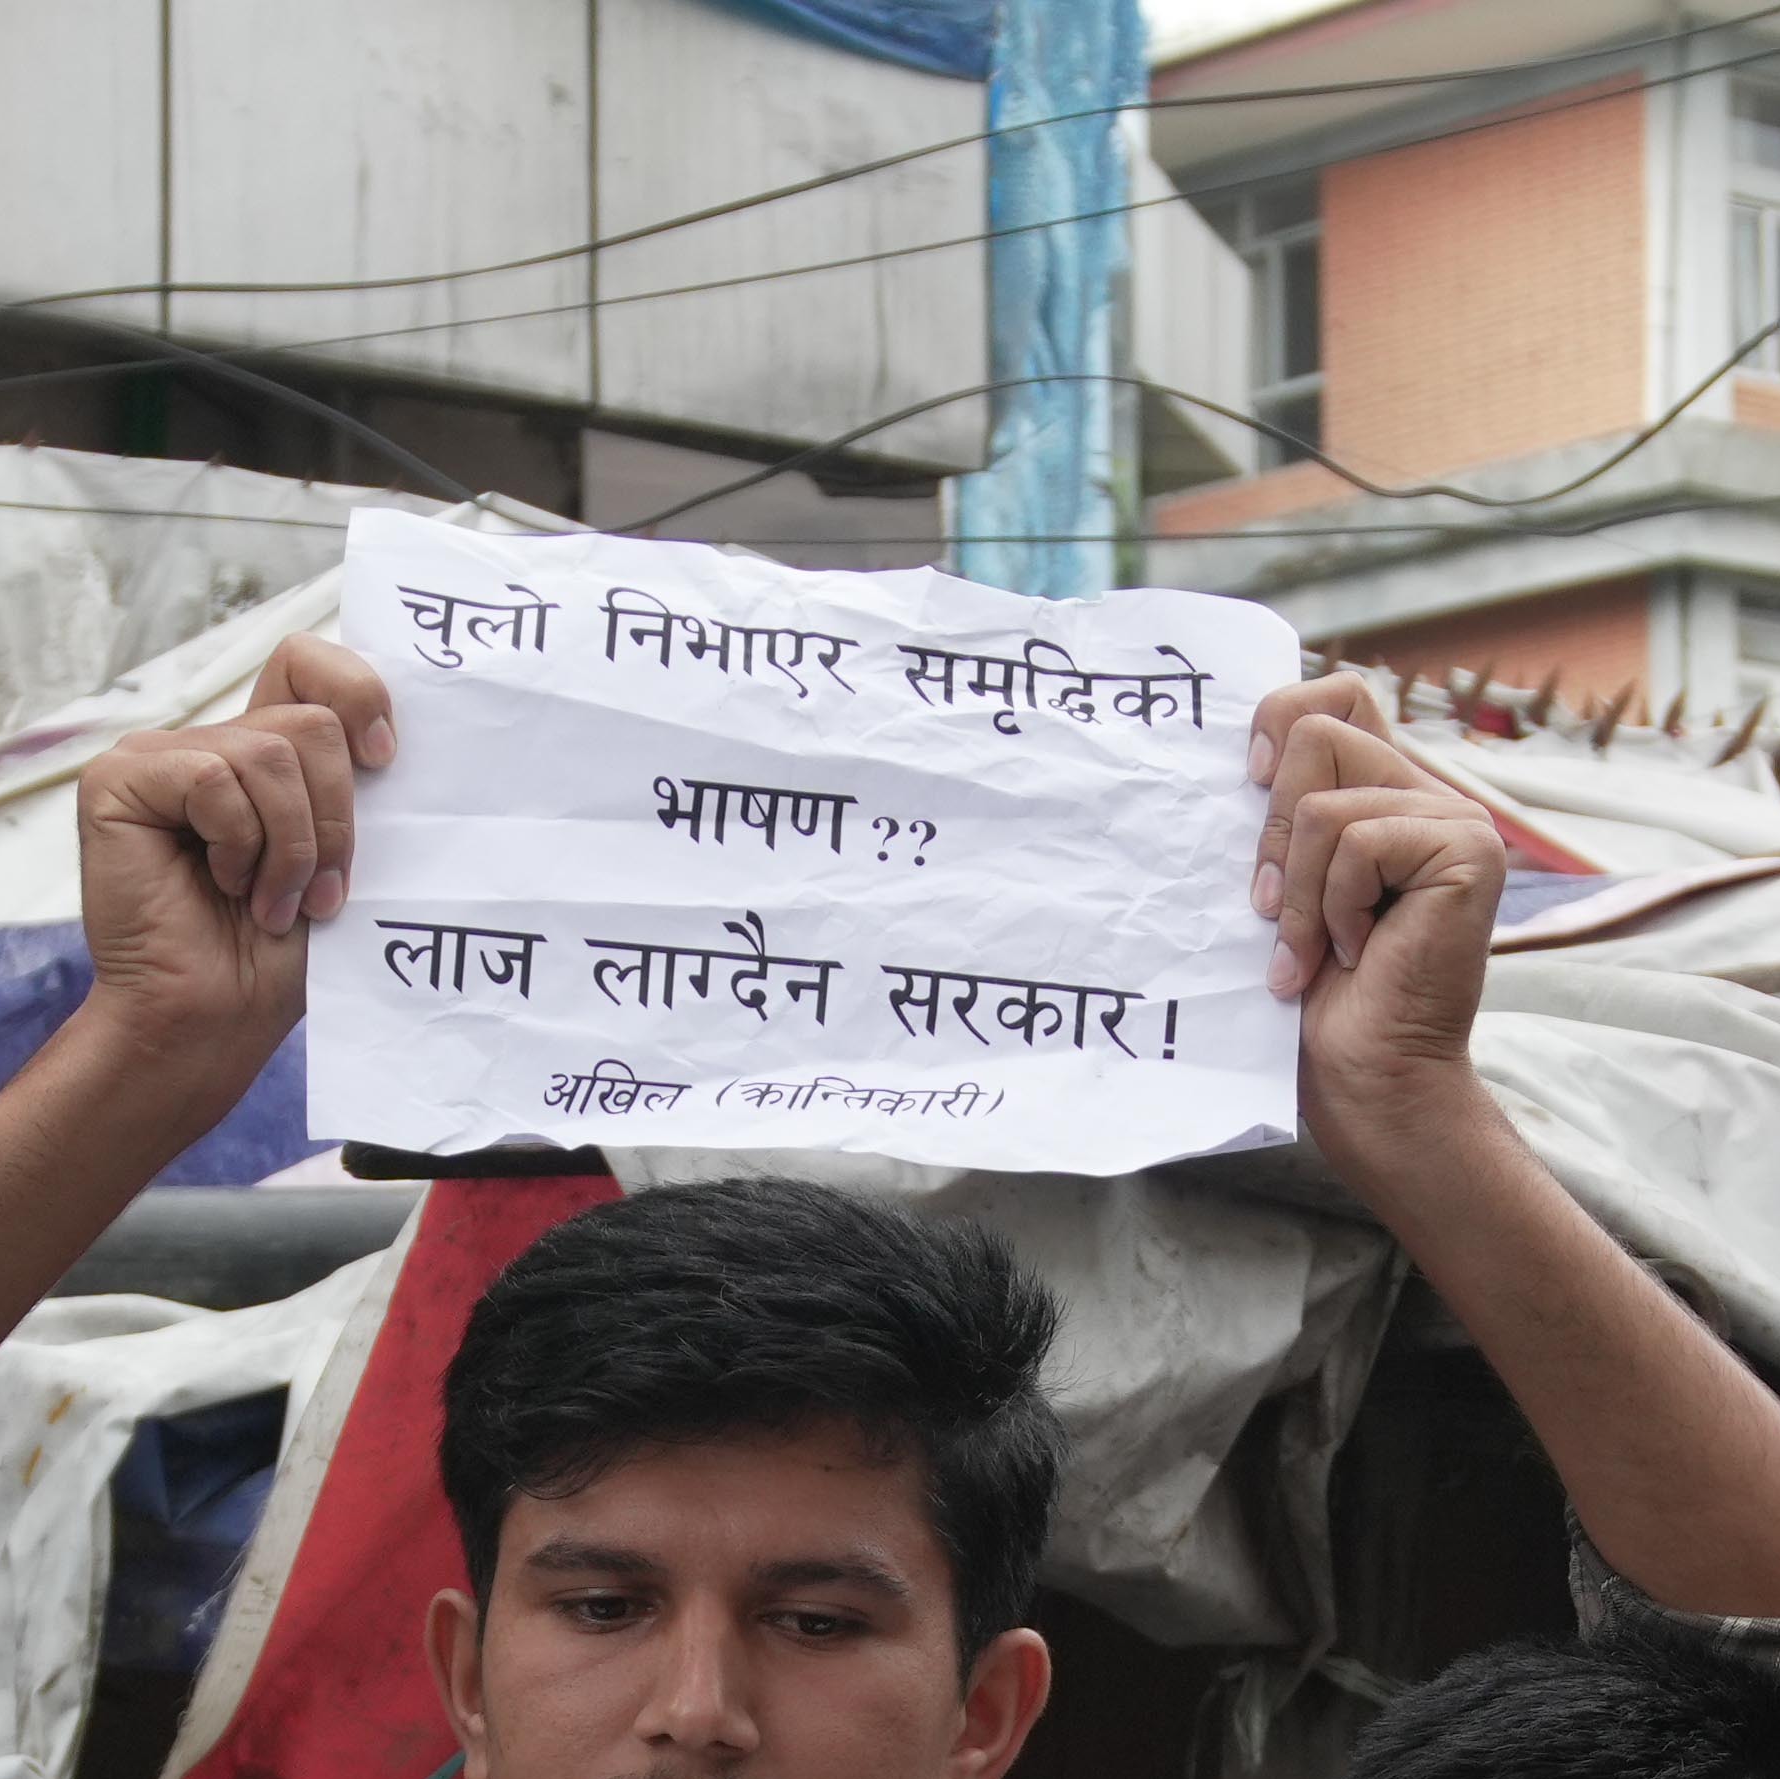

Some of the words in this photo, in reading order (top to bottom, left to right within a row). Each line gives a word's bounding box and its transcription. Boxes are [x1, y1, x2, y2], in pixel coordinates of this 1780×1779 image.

[395, 583, 560, 669] चुलो
[597, 586, 861, 699] निभाएर
[374, 919, 548, 1000] लाज
[583, 909, 845, 1026] लाग्दैन
[543, 1058, 692, 1116] अखिल
